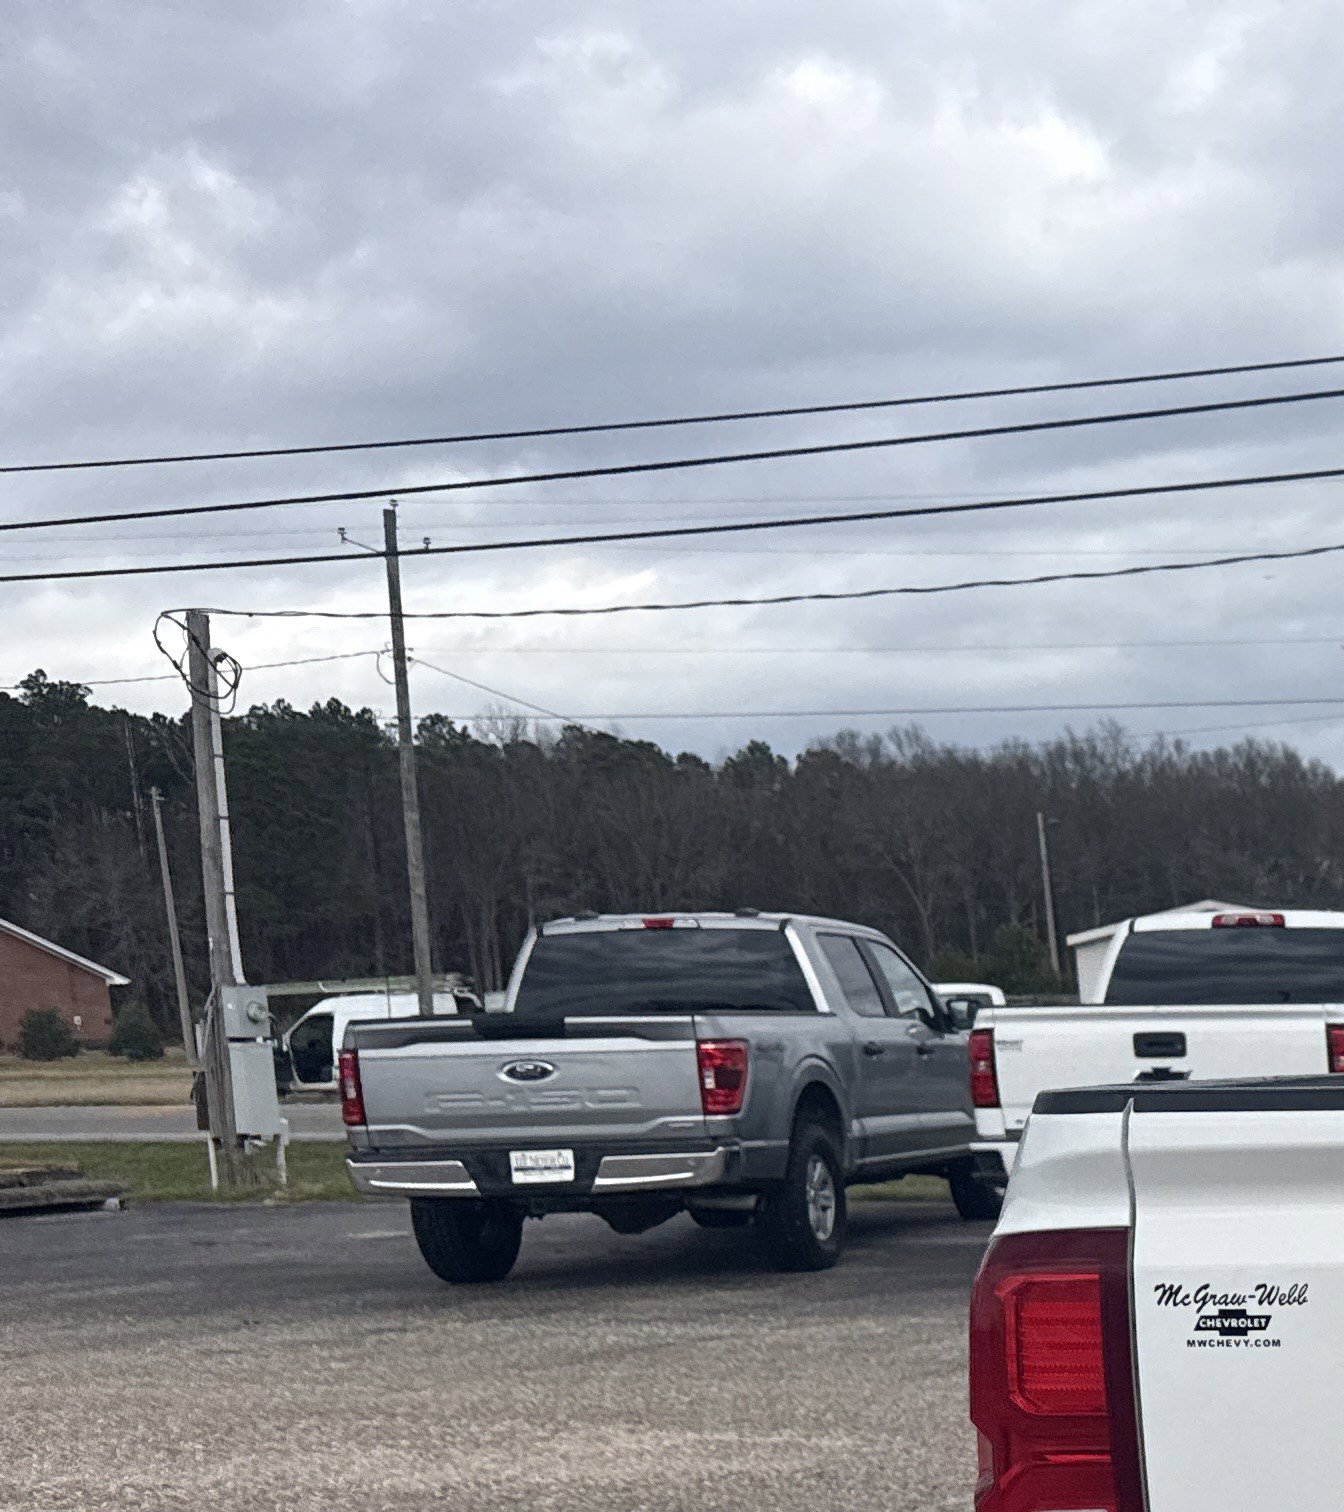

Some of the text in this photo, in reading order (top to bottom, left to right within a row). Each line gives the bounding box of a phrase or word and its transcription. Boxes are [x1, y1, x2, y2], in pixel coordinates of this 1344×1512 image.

[1153, 1282, 1309, 1314] McGraw-Webb
[1199, 1317, 1268, 1329] CHEVROLET
[1186, 1338, 1282, 1348] MWCHEVY.COM
